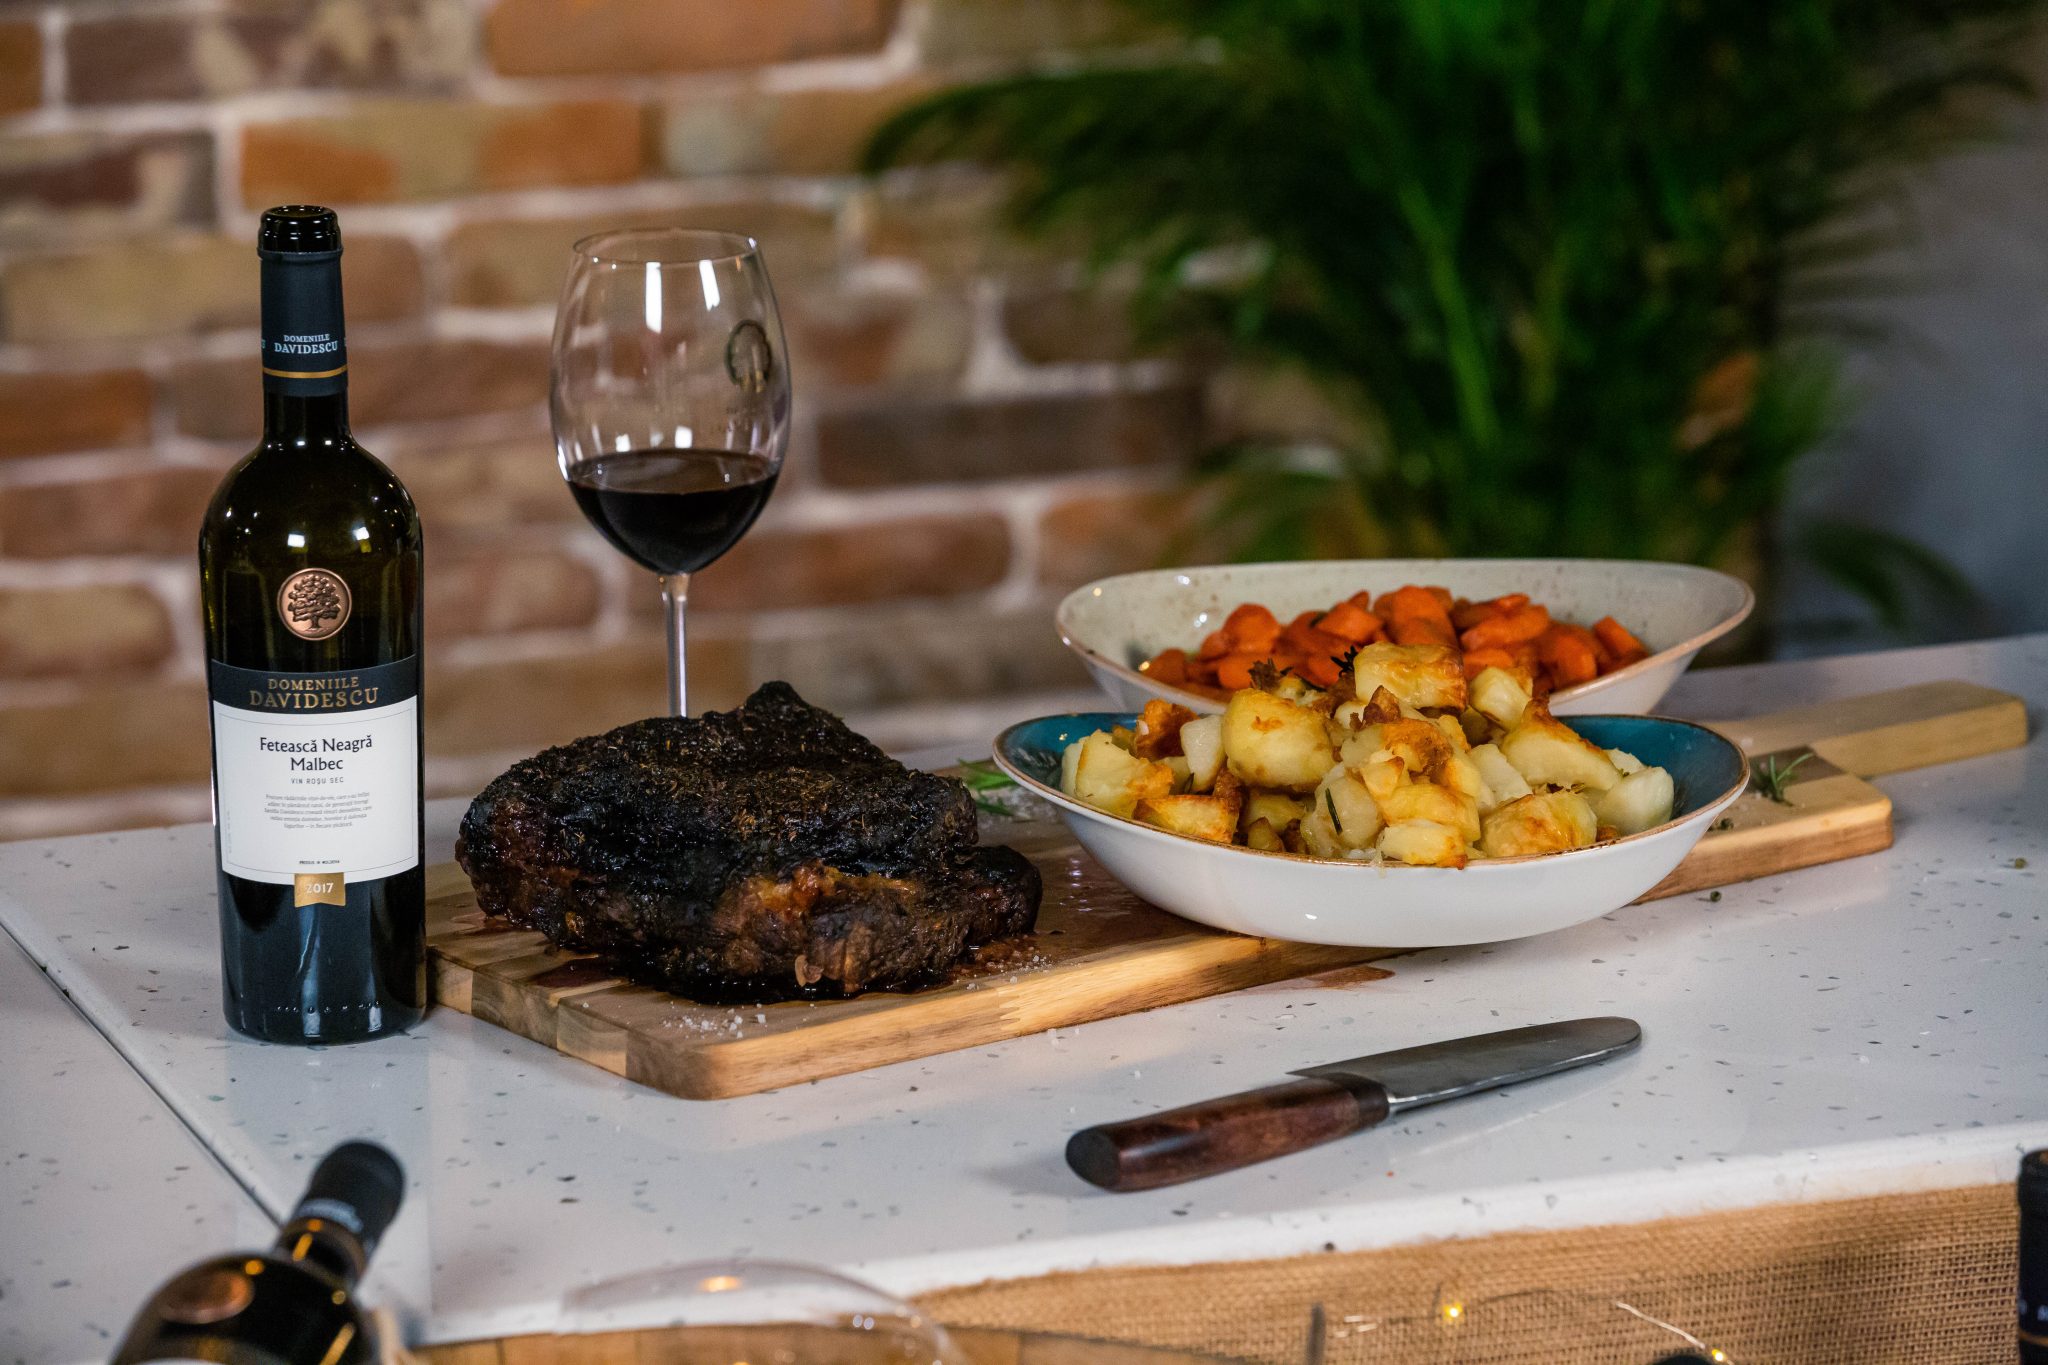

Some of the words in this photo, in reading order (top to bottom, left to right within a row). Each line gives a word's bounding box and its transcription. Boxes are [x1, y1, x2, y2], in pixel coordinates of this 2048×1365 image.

[284, 334, 330, 342] DOMENIILE
[274, 341, 338, 354] DAVIDESCU
[268, 677, 359, 689] DOMENIILE
[250, 687, 379, 709] DAVIDESCU
[260, 737, 317, 753] Fetească
[323, 734, 373, 752] Neagră
[291, 757, 343, 770] Malbec
[306, 883, 334, 893] 2017
